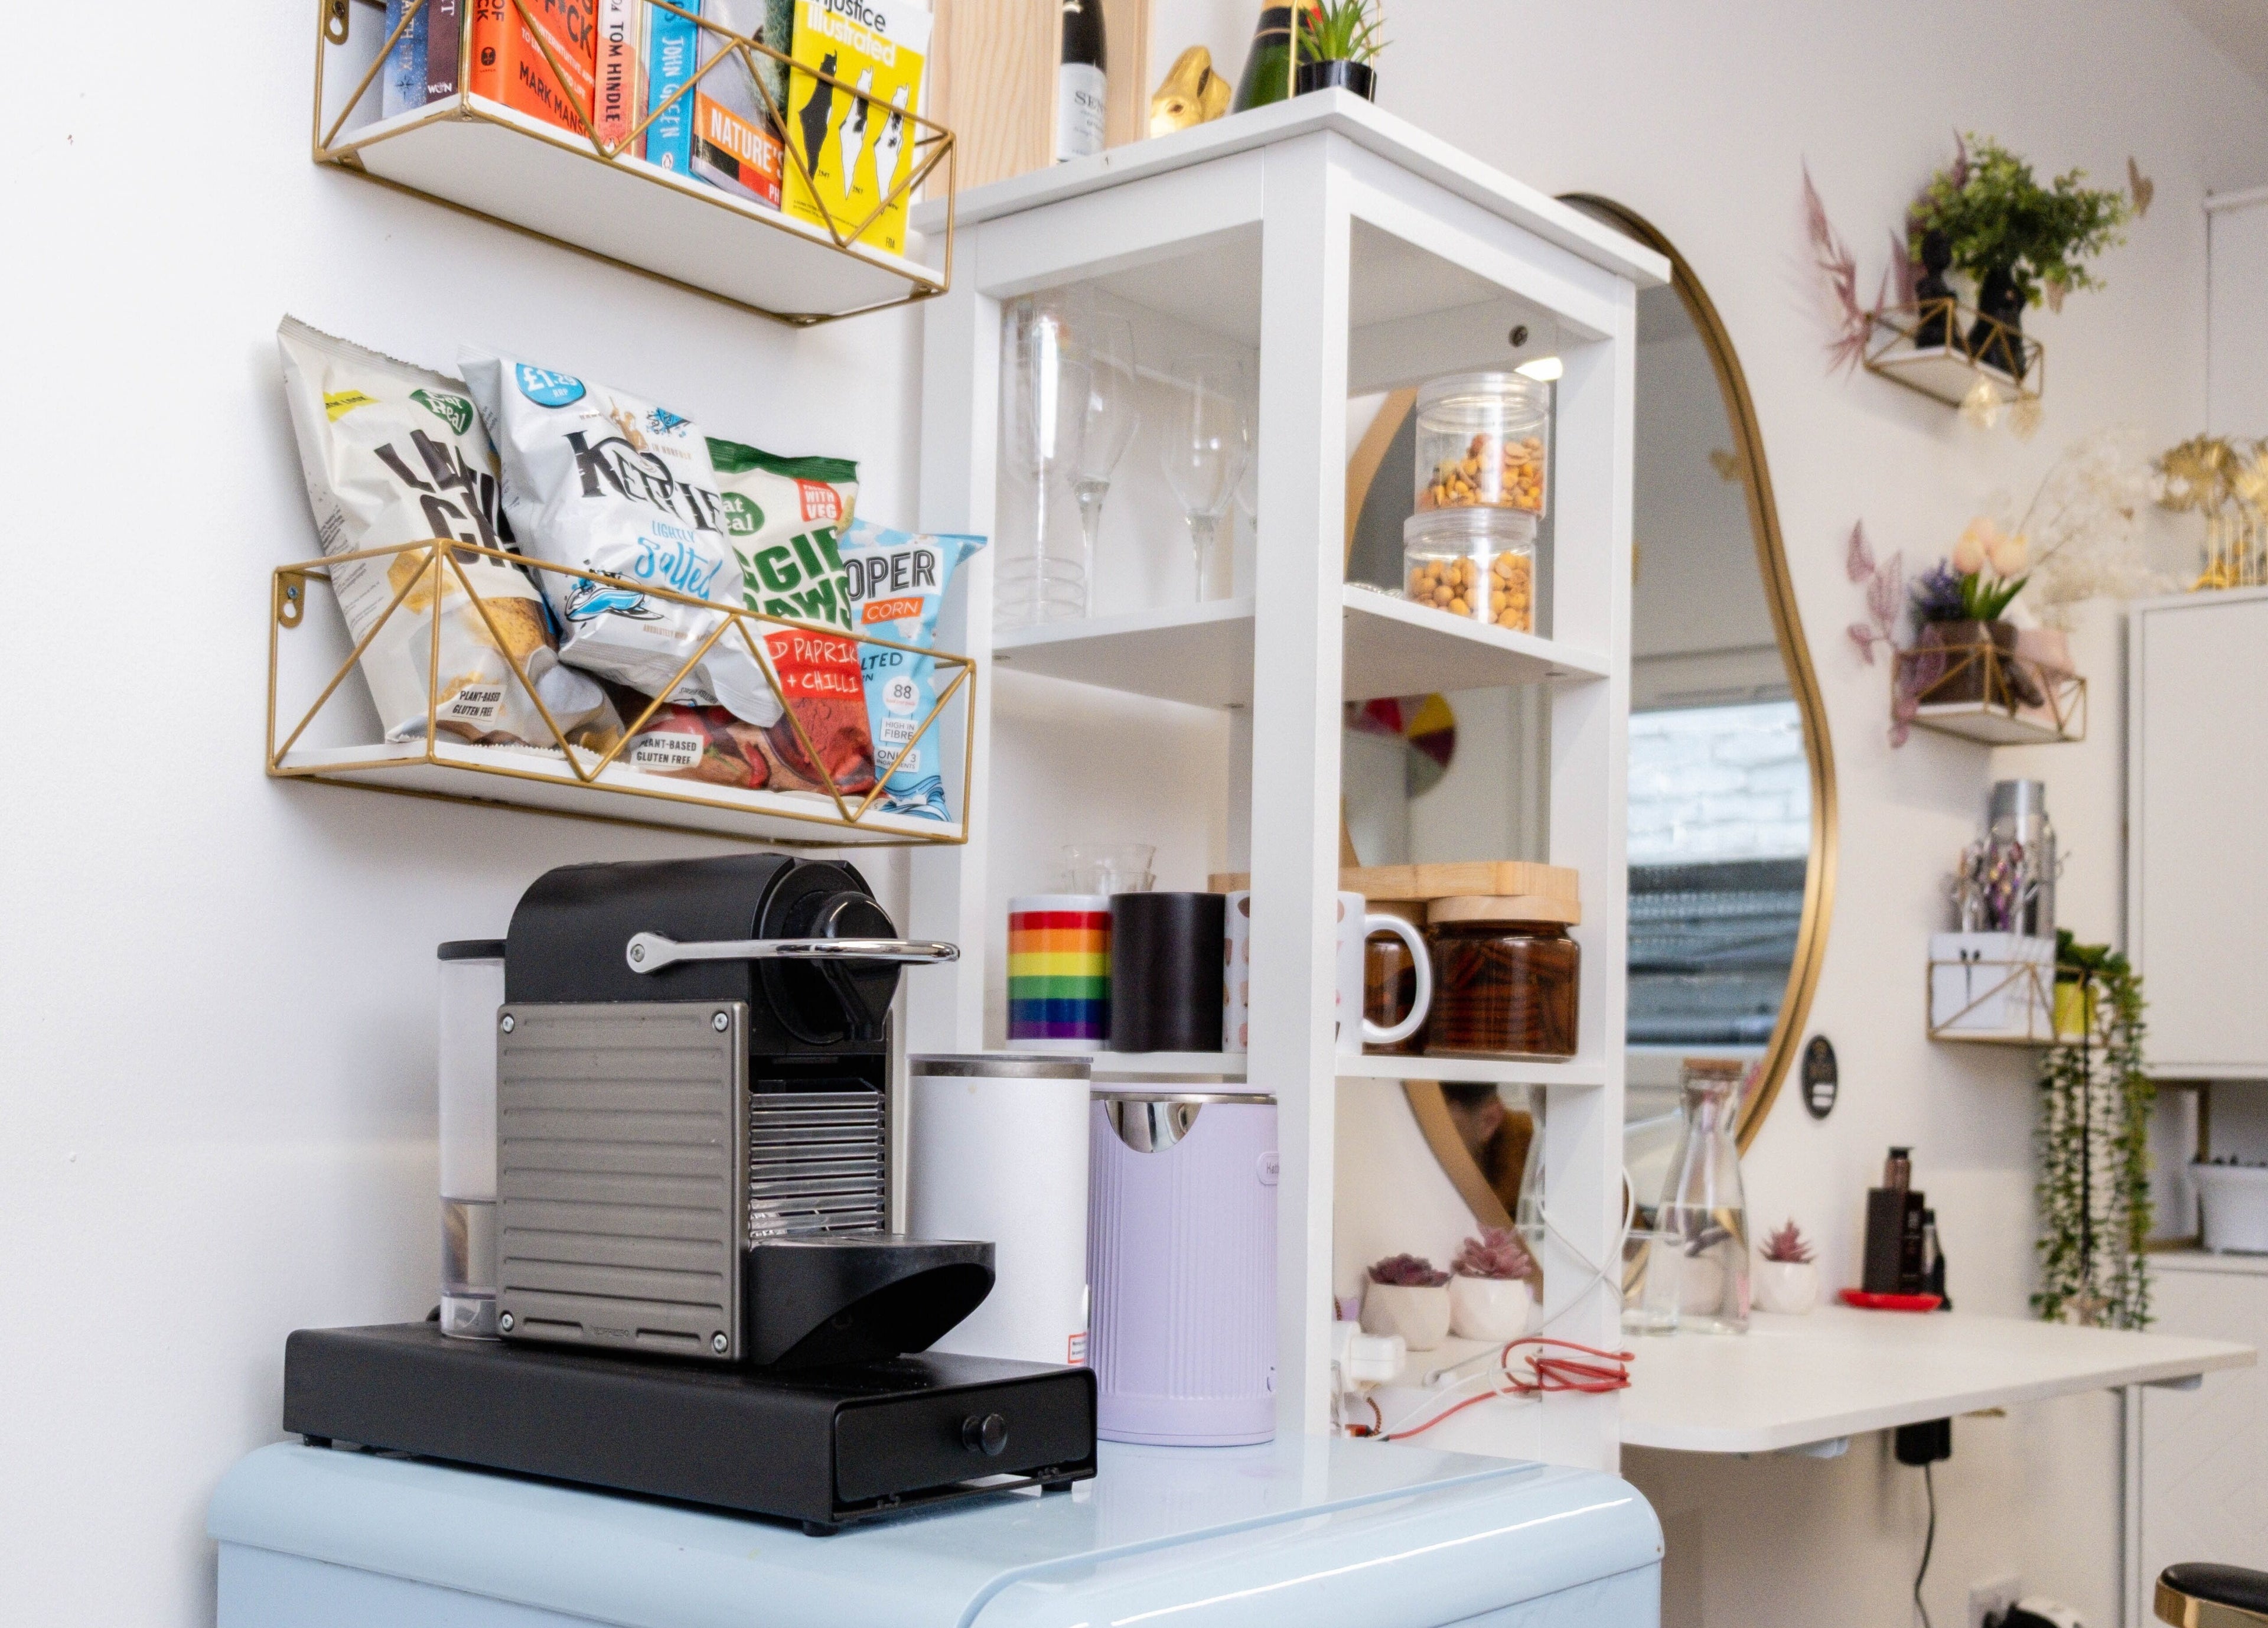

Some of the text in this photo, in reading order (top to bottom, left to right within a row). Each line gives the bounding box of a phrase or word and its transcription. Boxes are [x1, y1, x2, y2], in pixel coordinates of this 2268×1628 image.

[807, 3, 897, 68] Illustrated
[662, 36, 684, 77] JOHN
[605, 21, 624, 122] TOM HINDLE
[519, 60, 591, 139] MARK MANS
[1074, 90, 1105, 114] SEN
[426, 398, 466, 432] Real
[804, 490, 835, 503] WITH
[806, 503, 838, 520] VEG
[652, 520, 695, 543] LIGHTLY
[634, 536, 724, 601] Salted
[866, 601, 919, 620] CORN
[793, 637, 859, 664] PAPRIK
[801, 670, 859, 693] CHILLI
[893, 683, 912, 699] 88
[459, 691, 501, 702] PLANT-BASED
[452, 704, 494, 717] GLUTEN FREE
[884, 729, 914, 740] FIBRE
[885, 721, 905, 730] HIGH
[636, 751, 692, 764] GLUTEN FREE
[910, 754, 916, 763] 3
